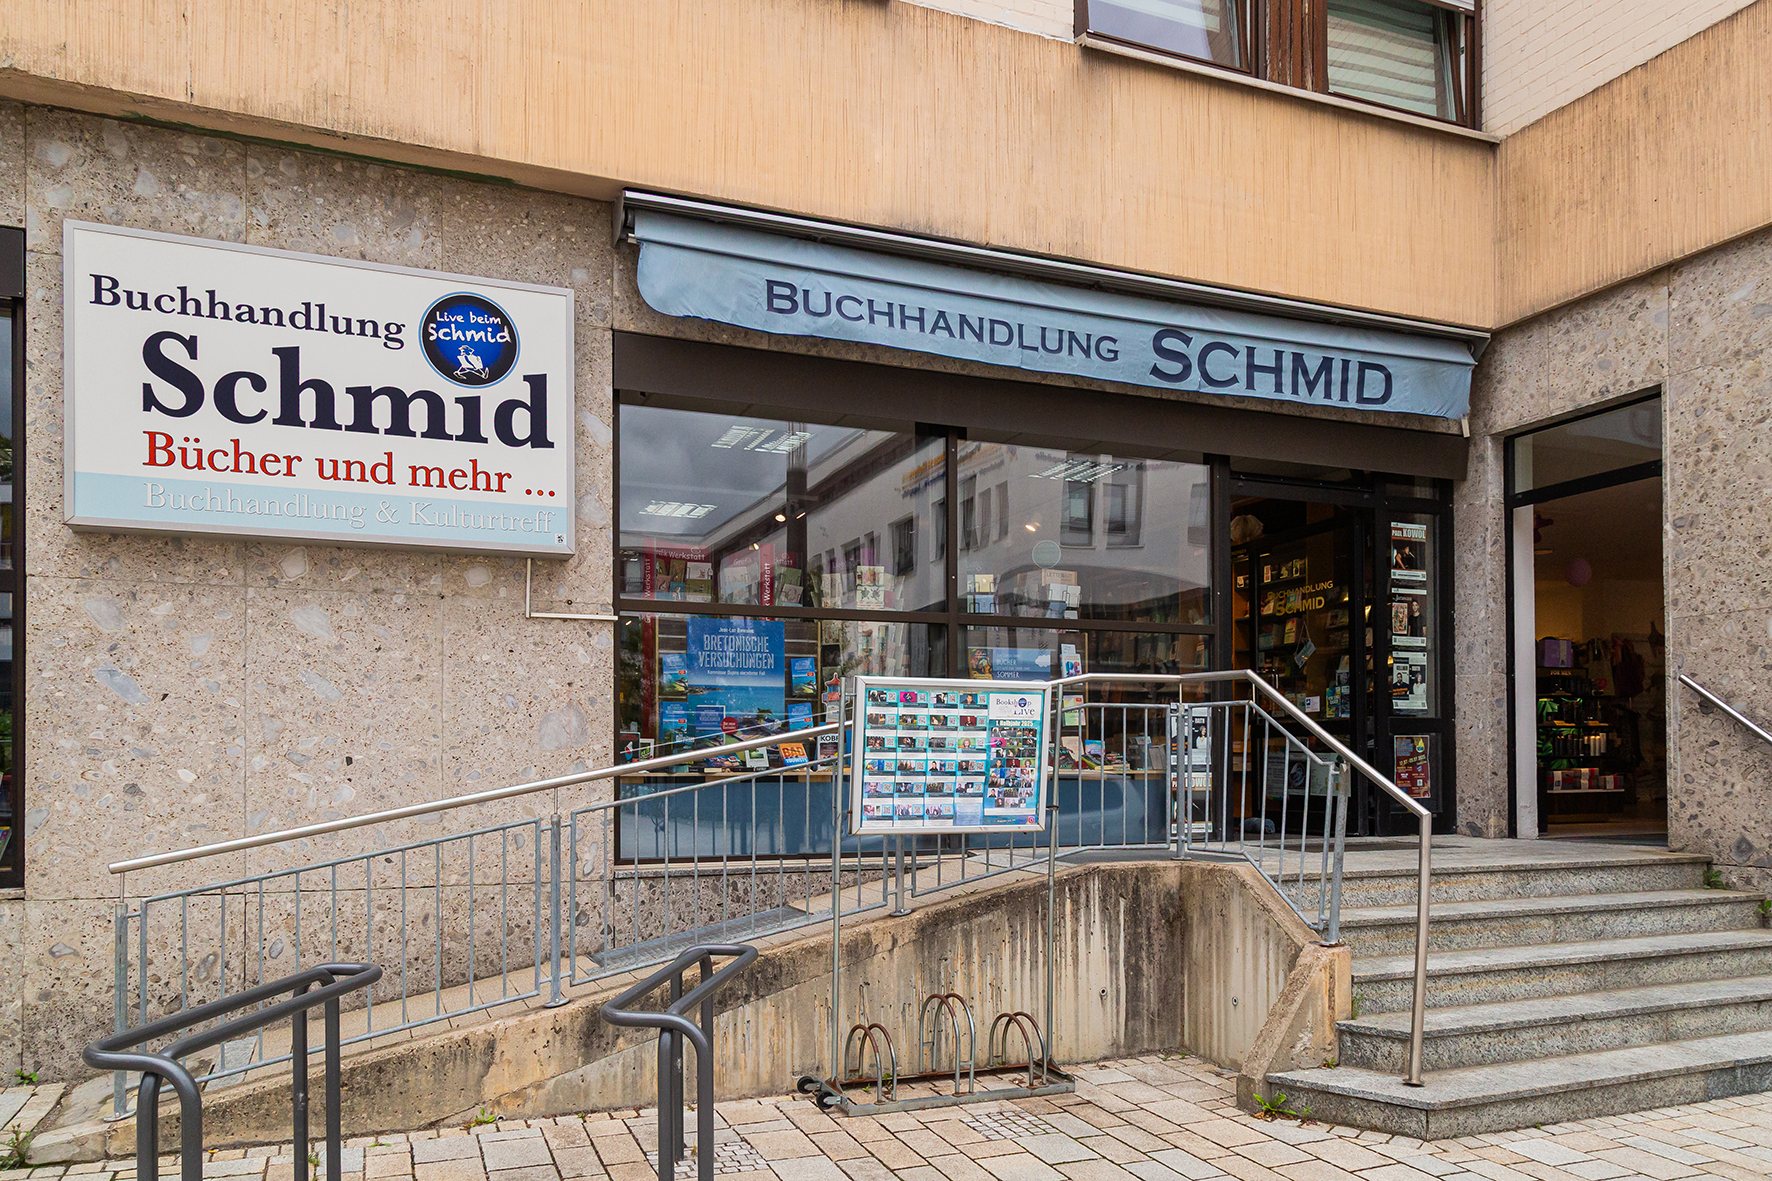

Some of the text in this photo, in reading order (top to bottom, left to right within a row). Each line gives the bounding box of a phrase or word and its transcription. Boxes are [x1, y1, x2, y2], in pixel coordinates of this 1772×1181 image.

[89, 273, 406, 351] Buchhandlung
[436, 311, 502, 325] Live beim
[427, 323, 512, 344] Schmid
[765, 279, 1393, 406] BUCHHANDLUNG SCHMID
[142, 331, 555, 450] Schmid
[143, 430, 302, 479] Bücher
[315, 451, 397, 486] und
[408, 458, 513, 494] mehr
[143, 482, 555, 534] Buchhandlung & Kulturtreff
[1403, 528, 1426, 539] KOWOL
[669, 550, 706, 561] Werkstatt
[1266, 580, 1334, 602] BUCHHANDLUNG
[1275, 596, 1325, 616] SCHMID
[704, 634, 769, 653] BRETONISCHE
[698, 651, 775, 670] VERSUCHUNGEN
[996, 671, 1020, 679] SOMMER
[782, 747, 806, 758] BAD
